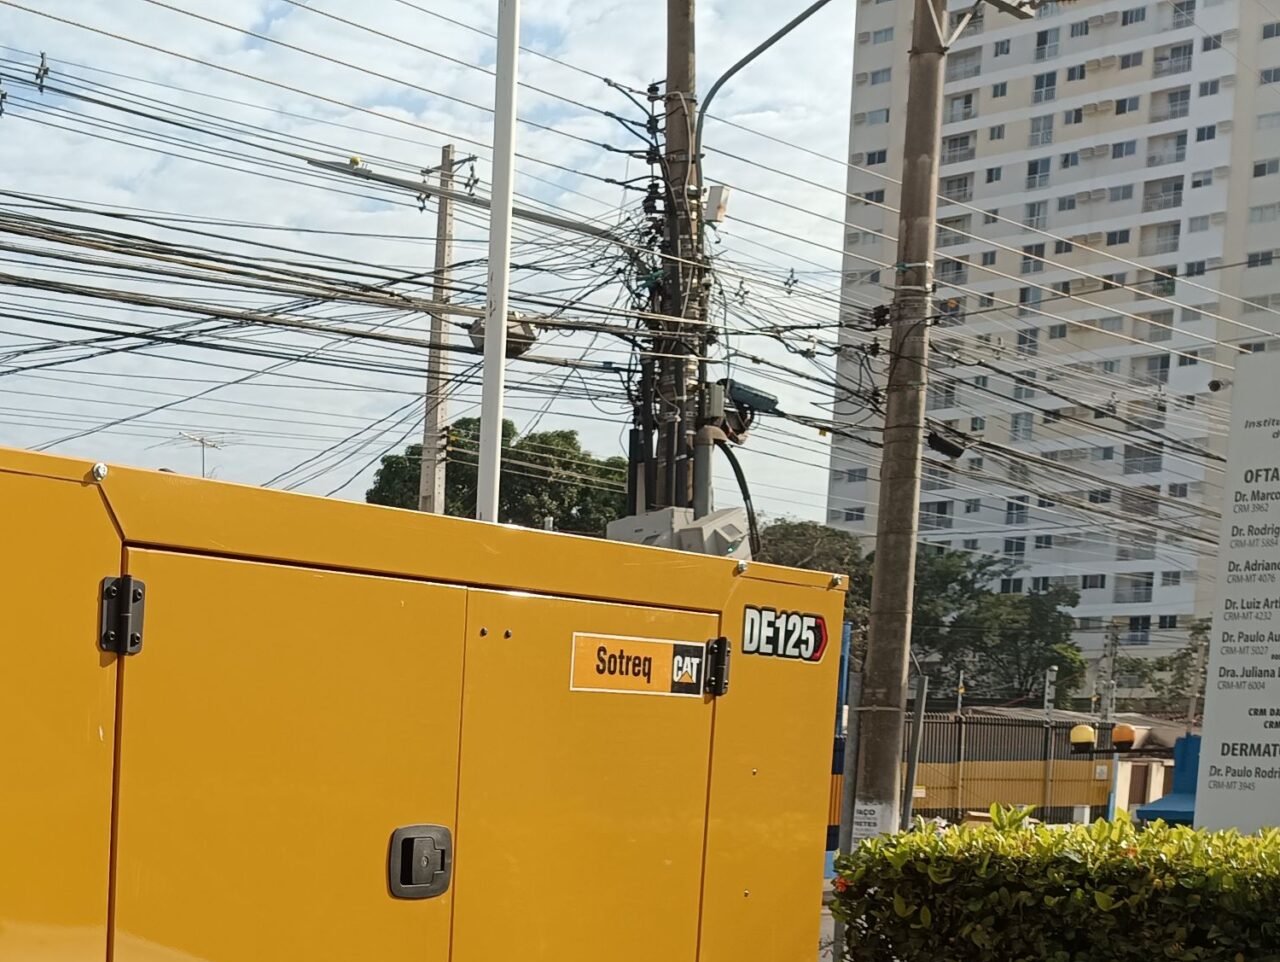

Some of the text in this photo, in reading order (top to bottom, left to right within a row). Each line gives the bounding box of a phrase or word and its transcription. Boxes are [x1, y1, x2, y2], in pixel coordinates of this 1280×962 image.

[1244, 467, 1280, 483] OFTA
[1234, 491, 1248, 502] Dr.
[1233, 504, 1249, 513] CRM
[1231, 523, 1280, 538] Dr. Rodrig
[1228, 560, 1242, 572] Dr.
[1227, 574, 1256, 584] CRM-MT
[1225, 597, 1280, 610] Dr. Luiz Art
[1223, 611, 1253, 621] CRM-MT
[743, 607, 816, 659] DE125
[1222, 631, 1235, 643] Dr.
[1238, 630, 1265, 643] Paulo
[1220, 645, 1249, 656] CRM-MT
[596, 646, 700, 683] Sotreq CAT
[1219, 666, 1238, 678] Dra.
[1240, 666, 1275, 678] Juliana
[1217, 680, 1247, 690] CRM-MT
[1248, 708, 1266, 716] CRM
[1221, 742, 1280, 757] DERMAT
[1209, 765, 1223, 777] Dr.
[1225, 765, 1252, 778] Paulo
[1208, 780, 1237, 790] CRM-MT
